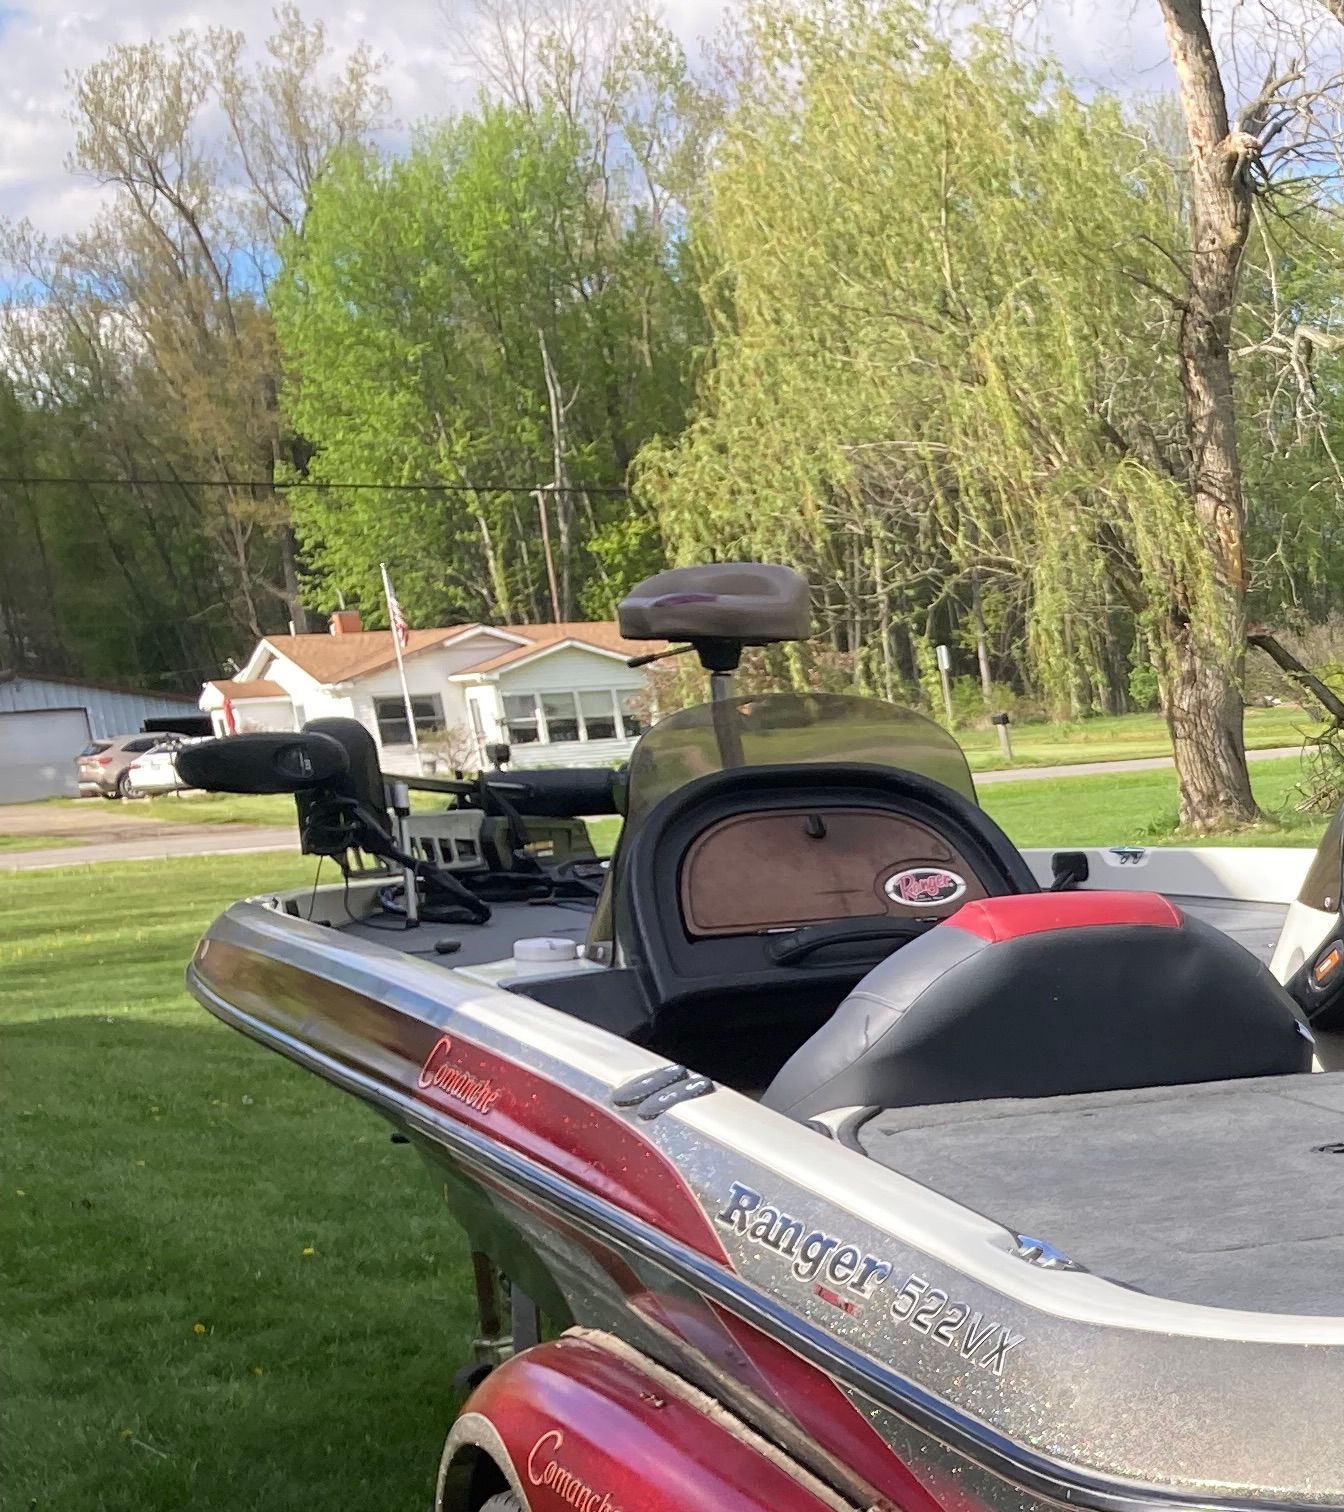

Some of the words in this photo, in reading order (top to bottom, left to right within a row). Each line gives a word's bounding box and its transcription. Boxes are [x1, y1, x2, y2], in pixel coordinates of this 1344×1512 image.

[896, 874, 952, 902] Ranger
[418, 1034, 501, 1116] Comanche
[715, 1180, 895, 1299] Ranger
